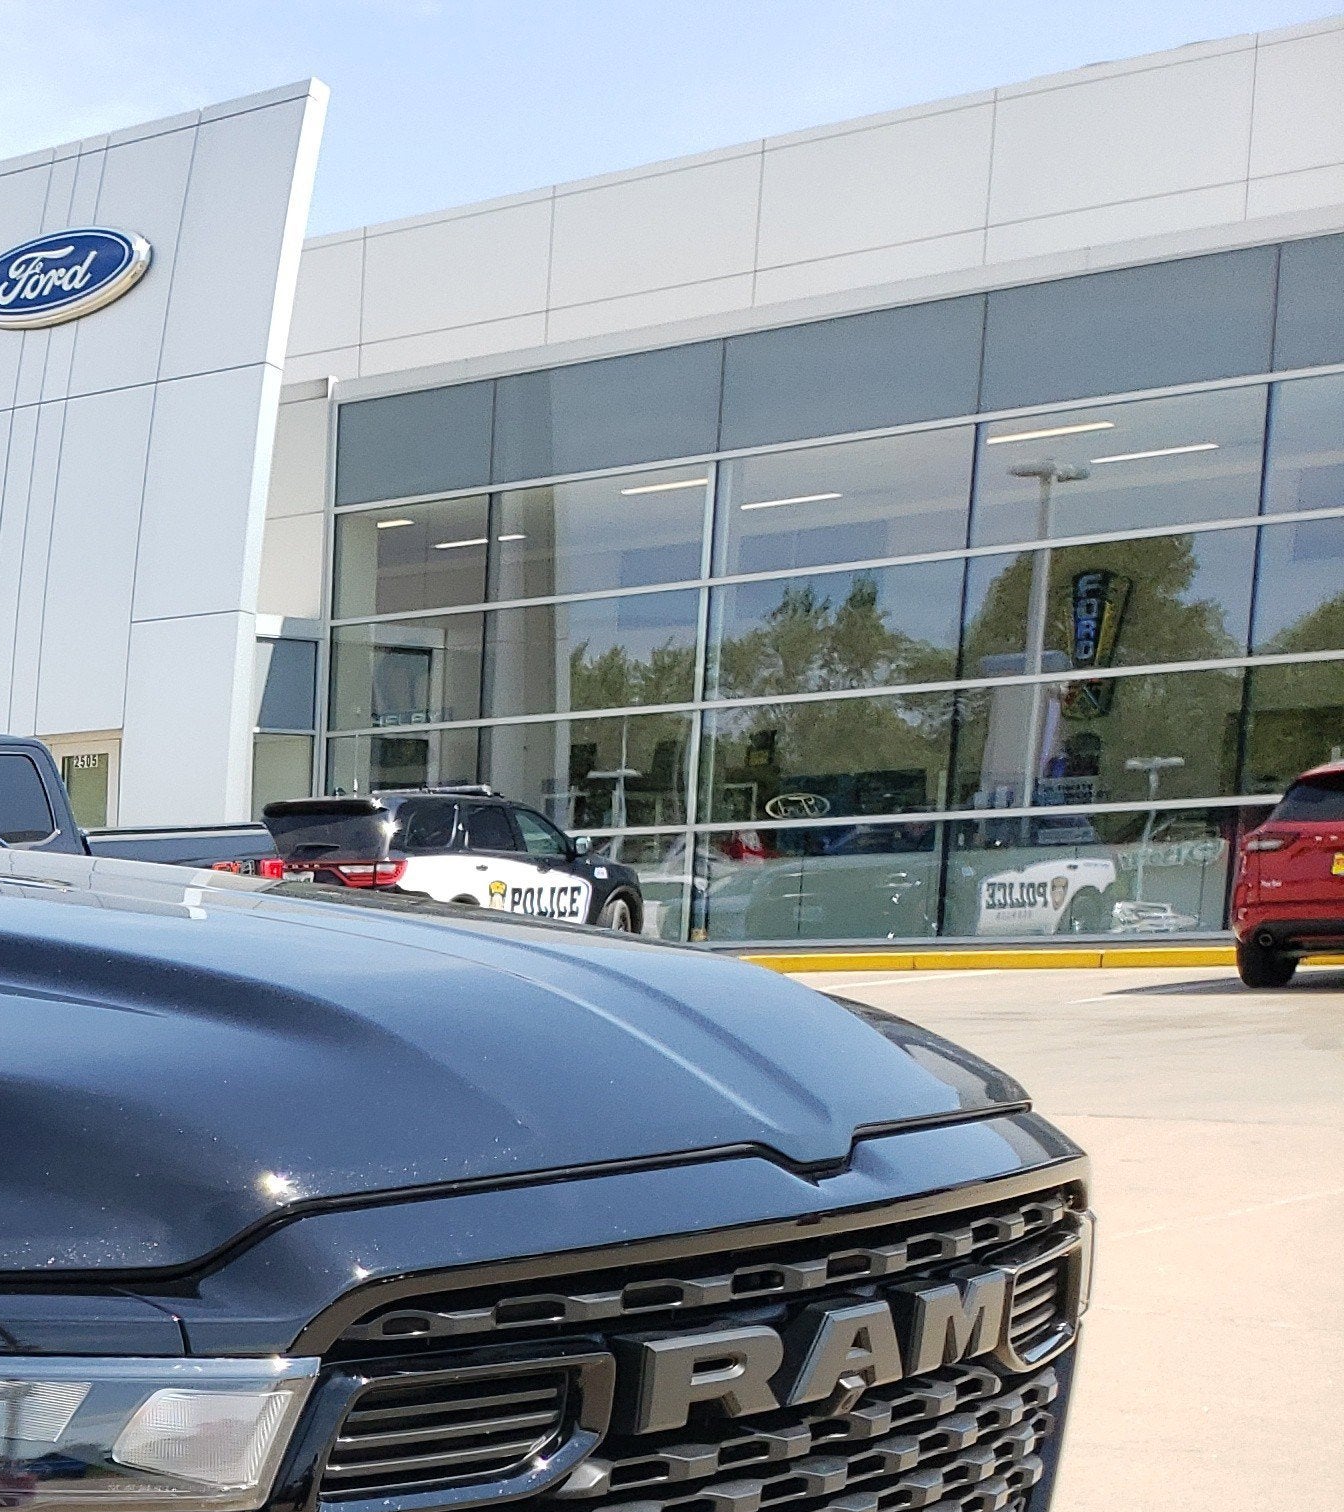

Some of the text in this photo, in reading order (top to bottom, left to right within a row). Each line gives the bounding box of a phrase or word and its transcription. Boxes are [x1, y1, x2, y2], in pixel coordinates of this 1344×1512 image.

[1077, 573, 1103, 661] FORD
[74, 754, 98, 768] 2505
[511, 885, 582, 918] POLICE
[632, 1268, 1008, 1436] RAM
